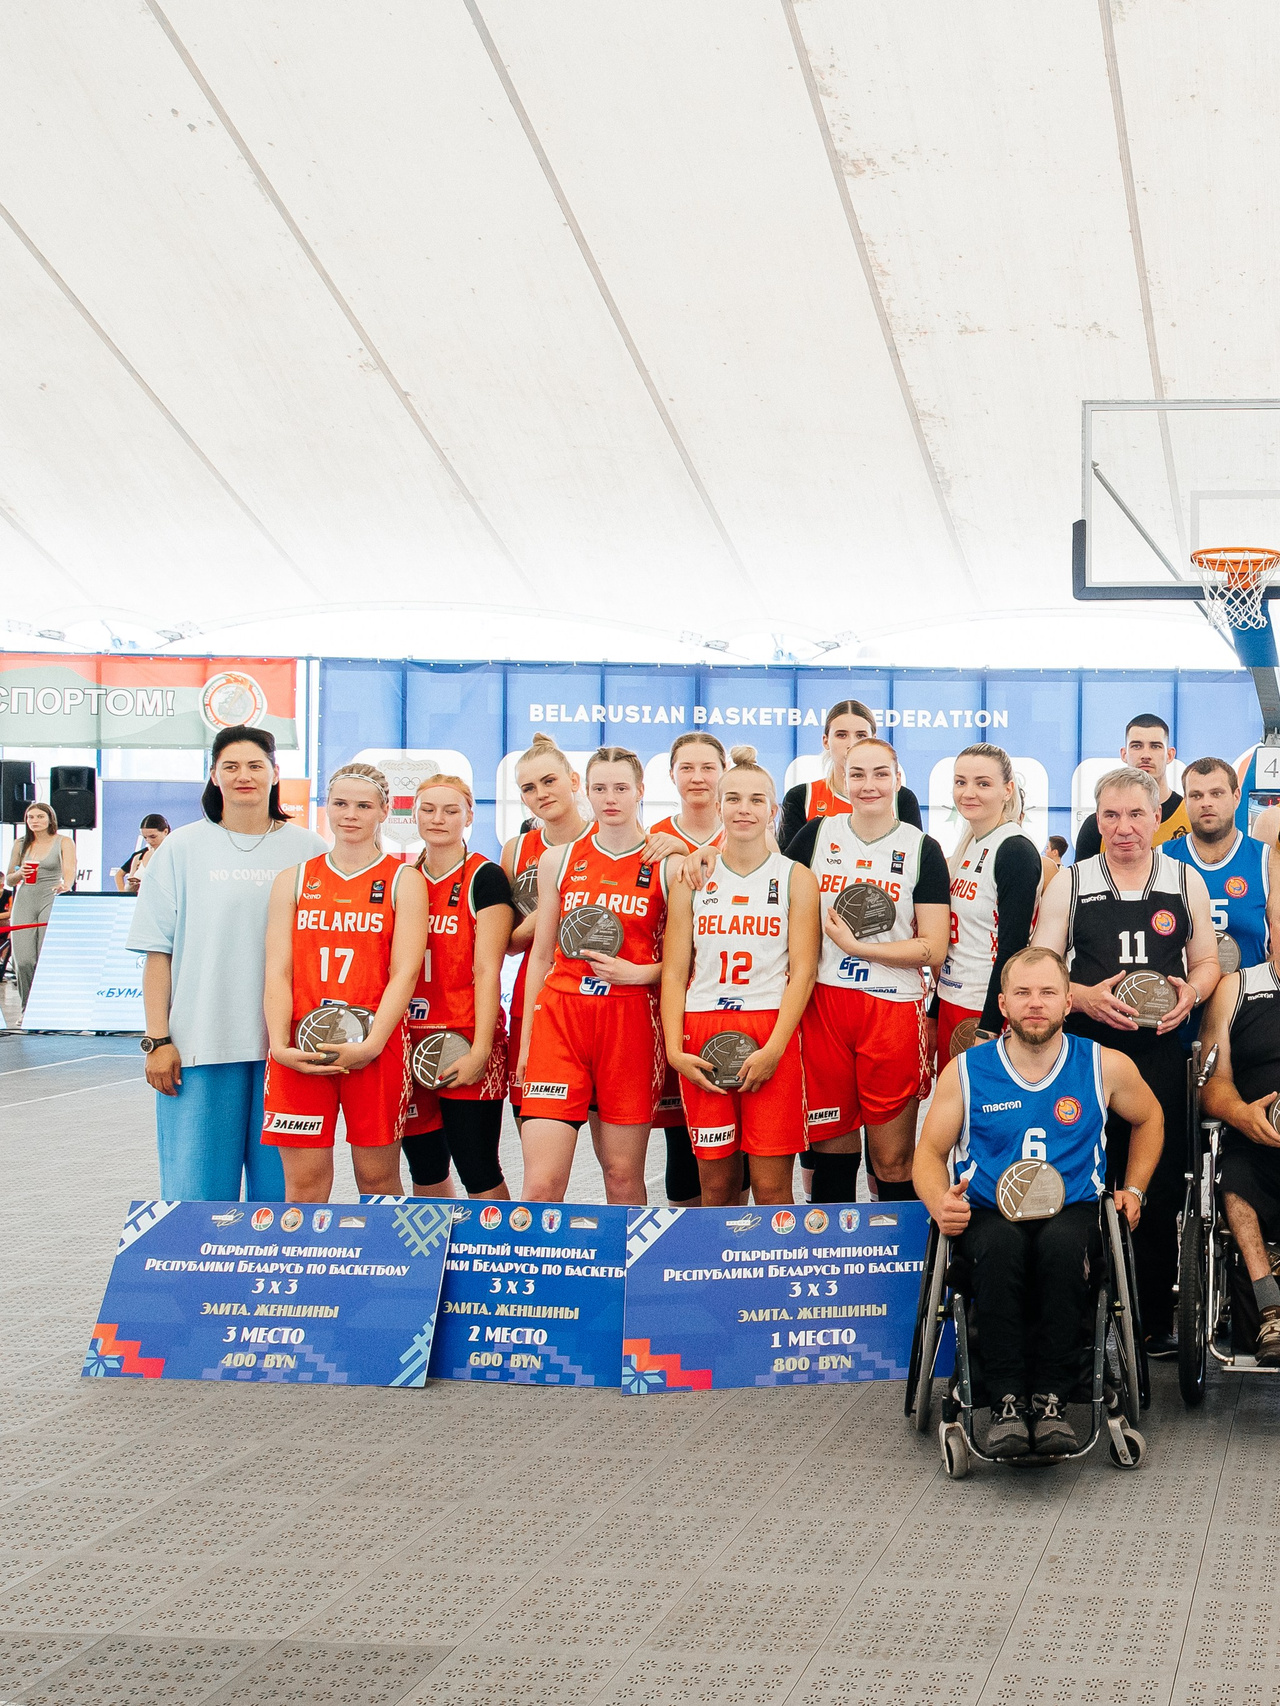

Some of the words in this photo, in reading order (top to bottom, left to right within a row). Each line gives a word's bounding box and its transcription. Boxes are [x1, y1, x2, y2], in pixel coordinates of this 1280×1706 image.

[529, 703, 685, 724] BELARUSIAN
[875, 709, 1009, 729] EDERATION
[1263, 757, 1280, 778] 4
[950, 878, 978, 901] ARUS
[297, 909, 384, 933] BELARUS
[428, 915, 459, 935] RUS
[698, 914, 782, 937] BELARUS
[1118, 930, 1149, 964] 11
[319, 946, 355, 984] 17
[719, 950, 753, 985] 12
[530, 1085, 567, 1094] ЭЛЕМЕНТ
[808, 1109, 839, 1121] ЛЕМЕНТ
[982, 1099, 1022, 1114] macron
[273, 1118, 322, 1132] ЭЛЕМЕНТ
[700, 1128, 735, 1144] ЭЛЕМЕНТ
[1021, 1127, 1047, 1162] 6
[282, 1245, 362, 1259] ЧЕМПИОНАТ
[514, 1246, 598, 1260] ЧЕМПИОНАТ
[812, 1244, 900, 1260] ЧЕМПИОНАТ
[237, 1260, 304, 1275] БЕЛАРУСЬ
[306, 1263, 327, 1275] ПО
[329, 1263, 410, 1277] БАСКЕТБОЛУ
[472, 1259, 539, 1275] БЕЛАРУСЬ
[541, 1263, 562, 1276] ПО
[767, 1262, 841, 1278] БЕЛАРУСЬ
[844, 1262, 865, 1275] ПО
[251, 1278, 265, 1294] 3
[284, 1278, 299, 1295] 3
[489, 1277, 502, 1294] 3
[521, 1279, 536, 1295] 3
[788, 1281, 802, 1298] 3
[824, 1280, 838, 1297] 3
[200, 1302, 251, 1316] ЭЛИТА.
[443, 1301, 492, 1317] ЭЛИТА.
[737, 1308, 794, 1323] ЭЛИТА.
[222, 1326, 237, 1343] 3
[240, 1327, 305, 1344] МЕСТО
[468, 1325, 481, 1342] 2
[485, 1326, 548, 1346] МЕСТО
[770, 1331, 782, 1348] 1
[788, 1328, 857, 1347] МЕСТО
[221, 1353, 257, 1368] 400
[263, 1354, 297, 1369] BYN
[469, 1352, 503, 1368] 600
[510, 1353, 542, 1370] BYN
[773, 1356, 810, 1373] 800
[818, 1355, 853, 1371] BYN
